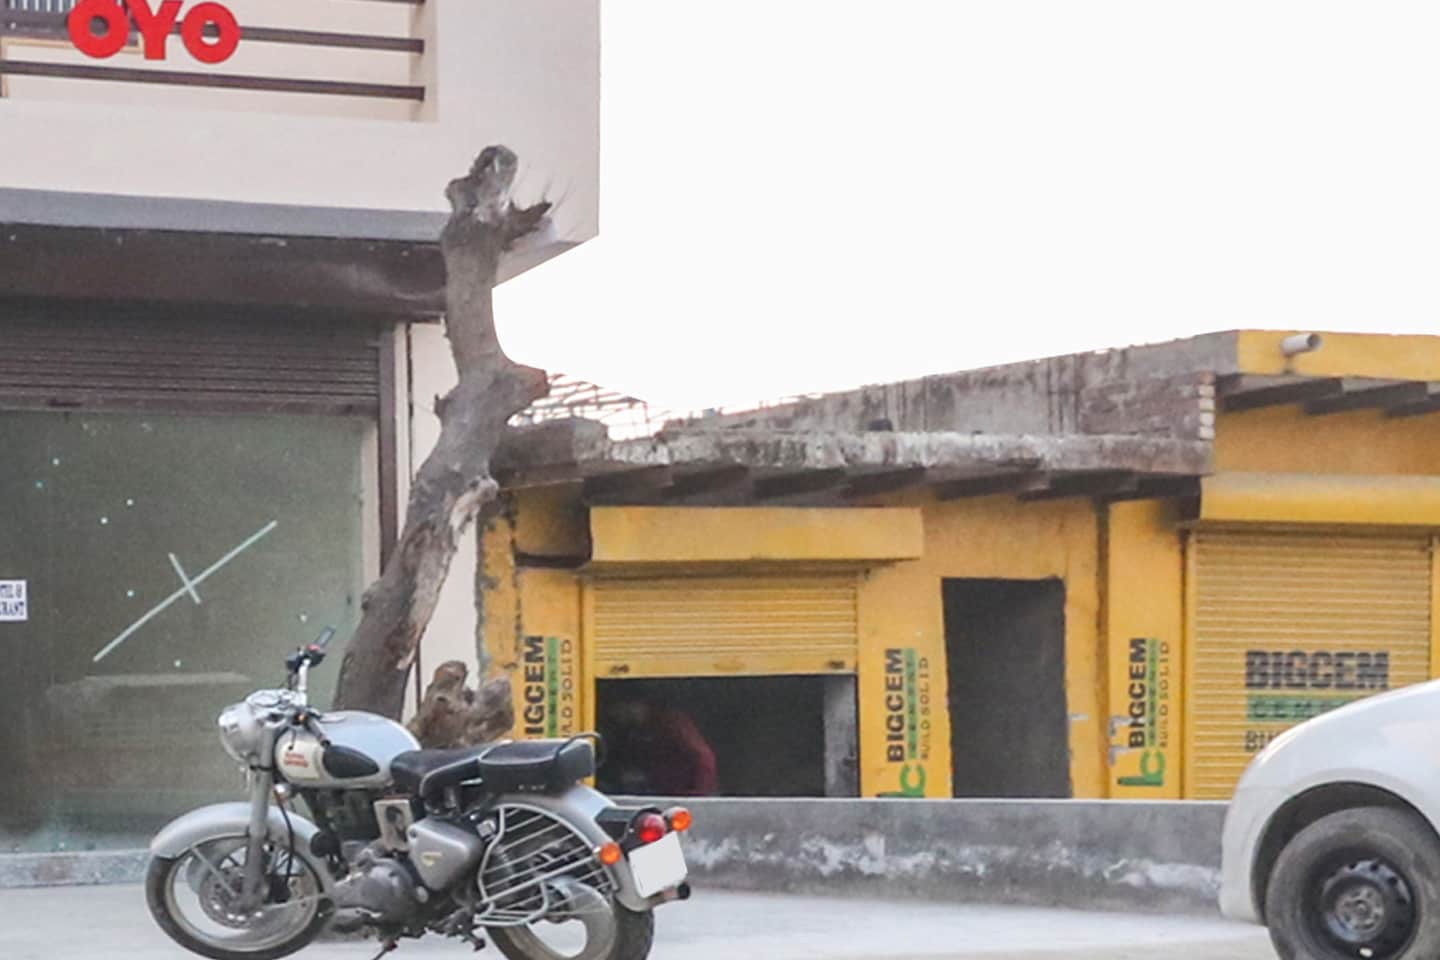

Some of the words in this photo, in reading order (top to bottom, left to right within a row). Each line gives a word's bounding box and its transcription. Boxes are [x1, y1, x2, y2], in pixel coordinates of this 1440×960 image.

[524, 635, 545, 735] IGCEM
[885, 648, 905, 762] BIGCEM
[919, 657, 930, 716] SOLID
[1128, 637, 1147, 748] BIGCEM
[1245, 651, 1389, 688] BIGCEM
